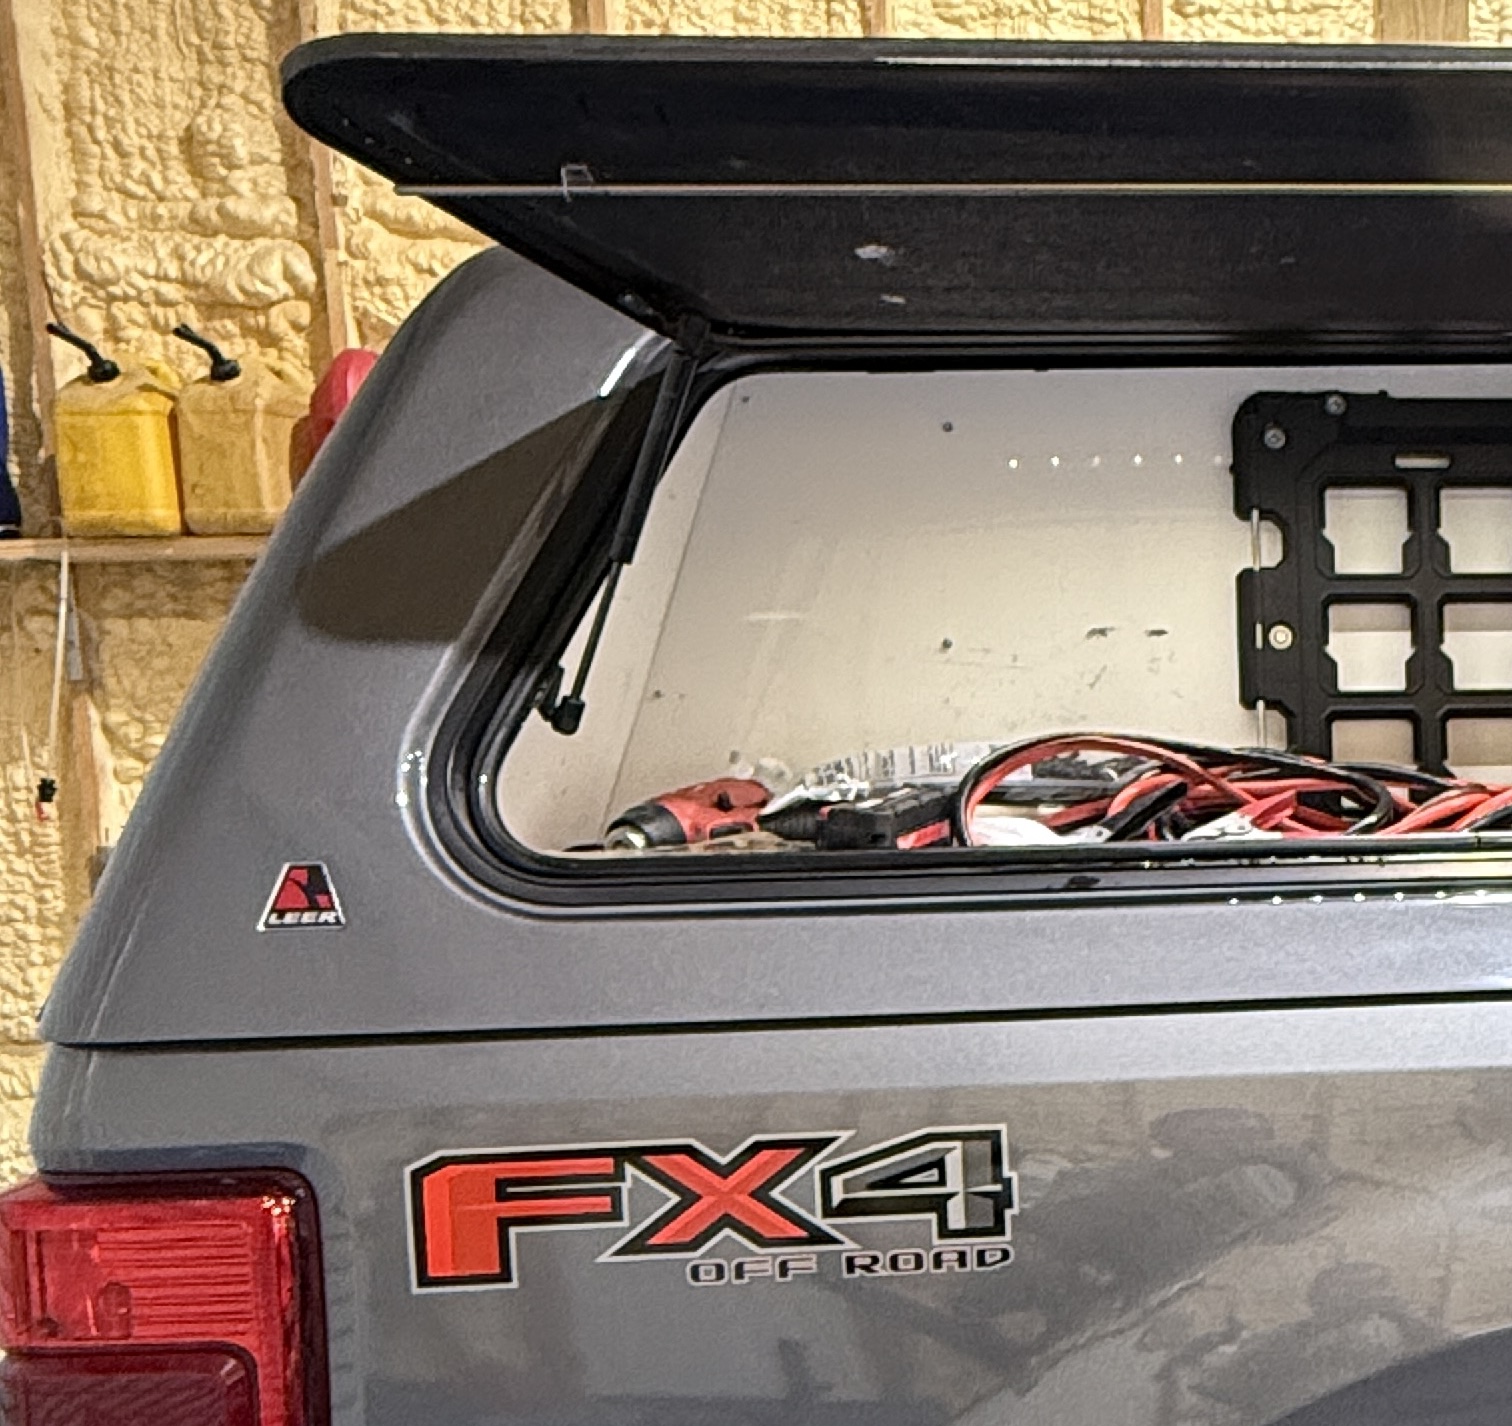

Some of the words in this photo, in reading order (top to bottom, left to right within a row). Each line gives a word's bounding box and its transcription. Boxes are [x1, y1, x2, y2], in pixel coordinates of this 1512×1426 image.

[408, 1124, 1020, 1293] FX4
[687, 1254, 820, 1286] OFF
[842, 1244, 1013, 1278] ROAD
